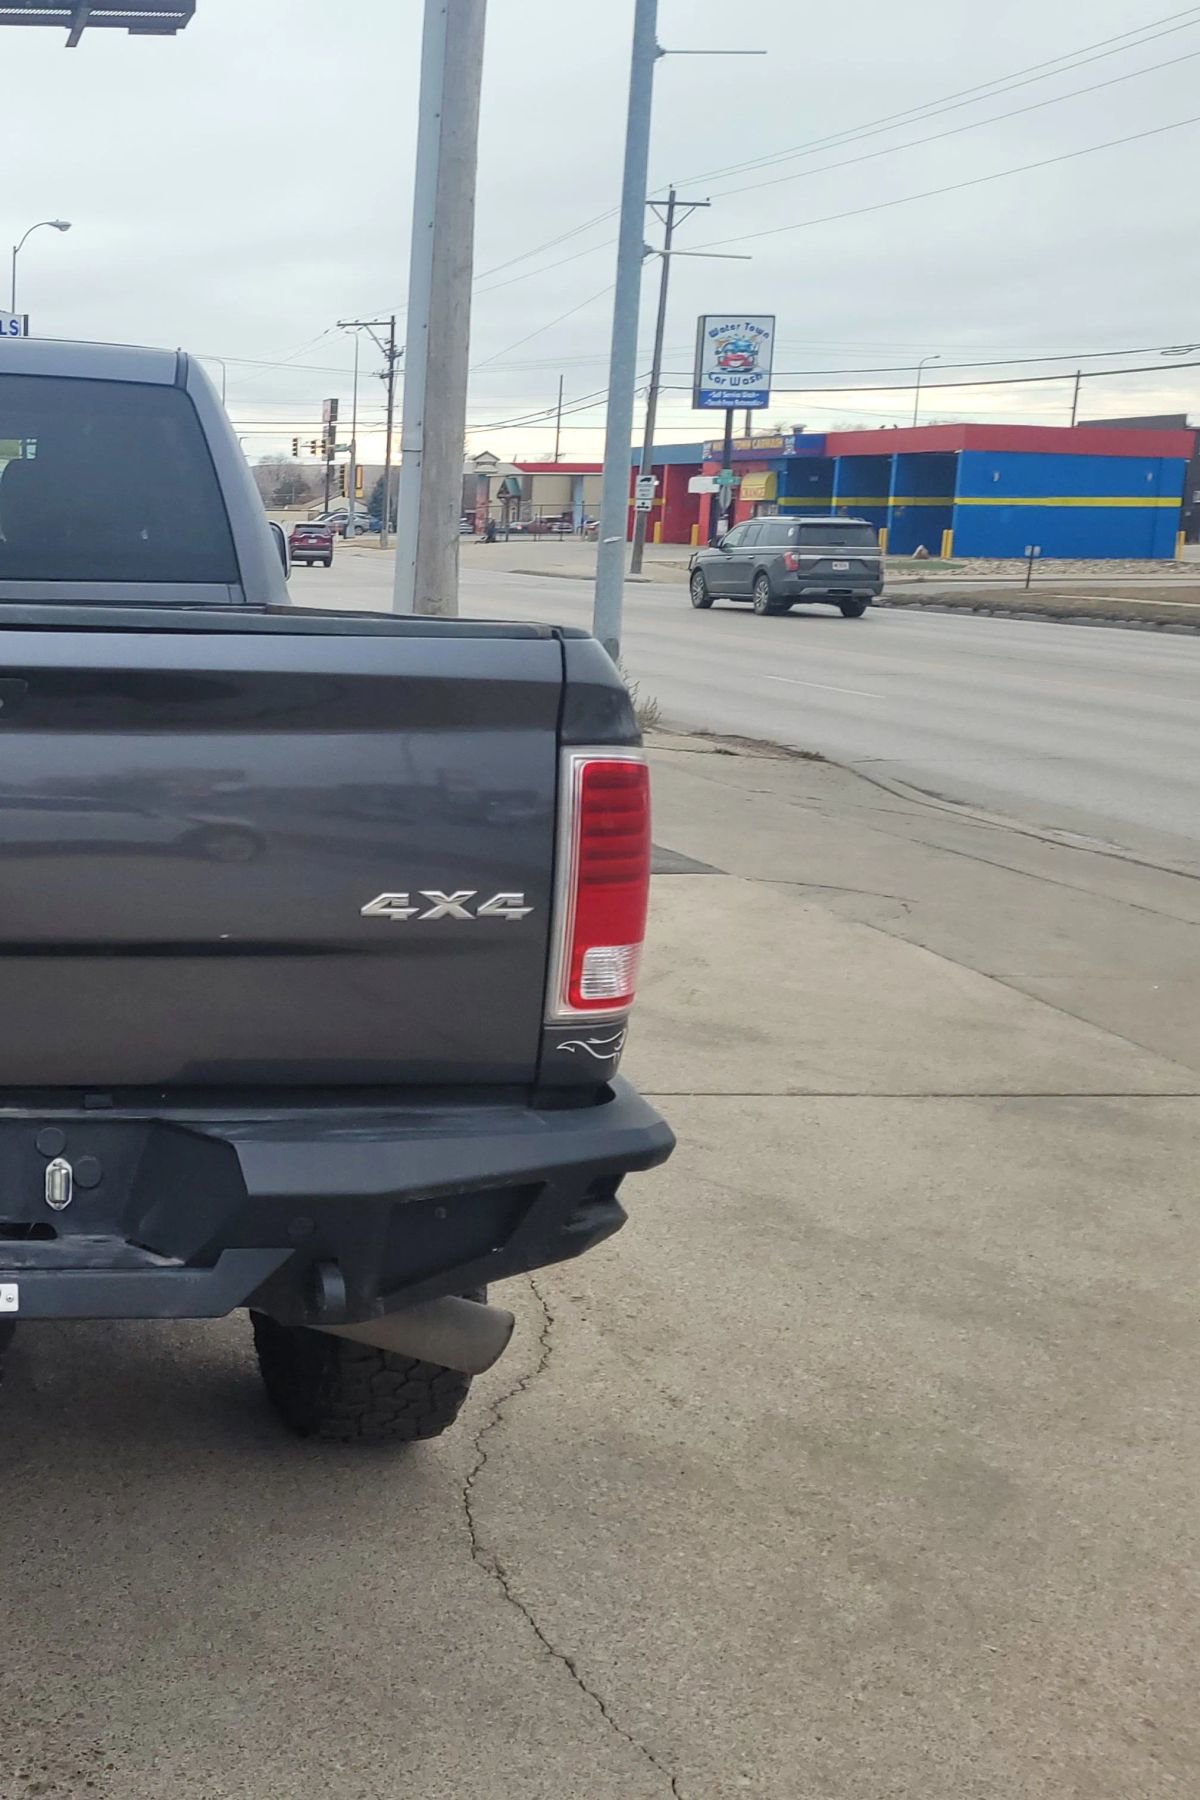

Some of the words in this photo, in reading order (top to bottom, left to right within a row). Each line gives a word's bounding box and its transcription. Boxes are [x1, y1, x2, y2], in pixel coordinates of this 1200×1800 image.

[708, 323, 741, 338] Water
[744, 322, 770, 339] Town
[708, 371, 727, 385] Car
[729, 373, 764, 386] Wash
